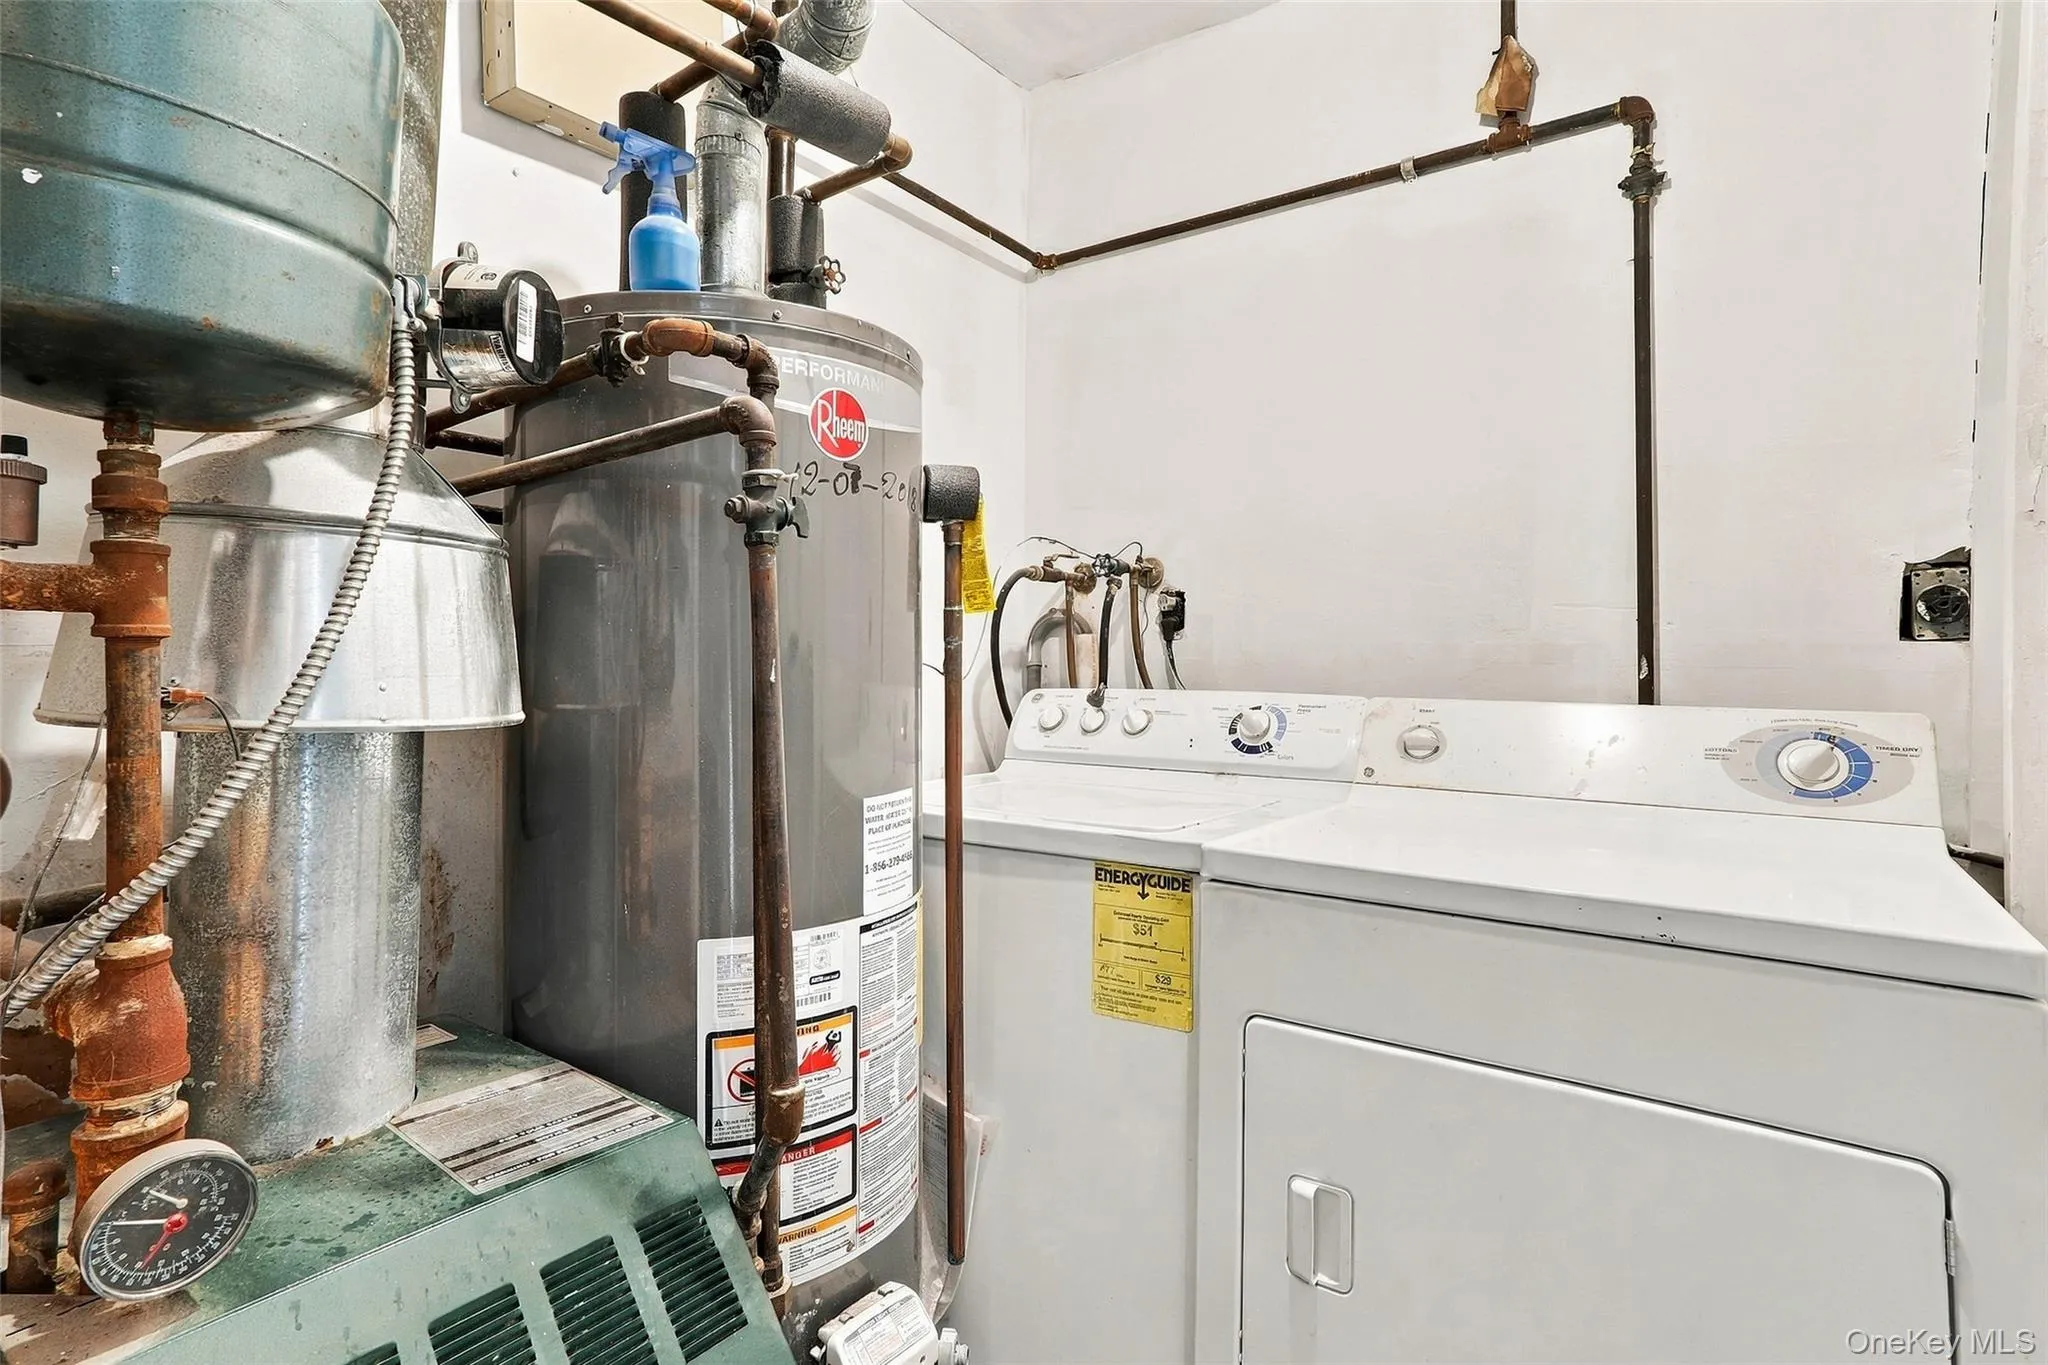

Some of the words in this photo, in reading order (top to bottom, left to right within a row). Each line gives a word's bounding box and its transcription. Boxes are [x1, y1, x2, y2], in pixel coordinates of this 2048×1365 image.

[816, 389, 866, 449] Rheem
[1094, 866, 1192, 894] ENERGYGUIDE
[781, 1146, 816, 1164] ANGER
